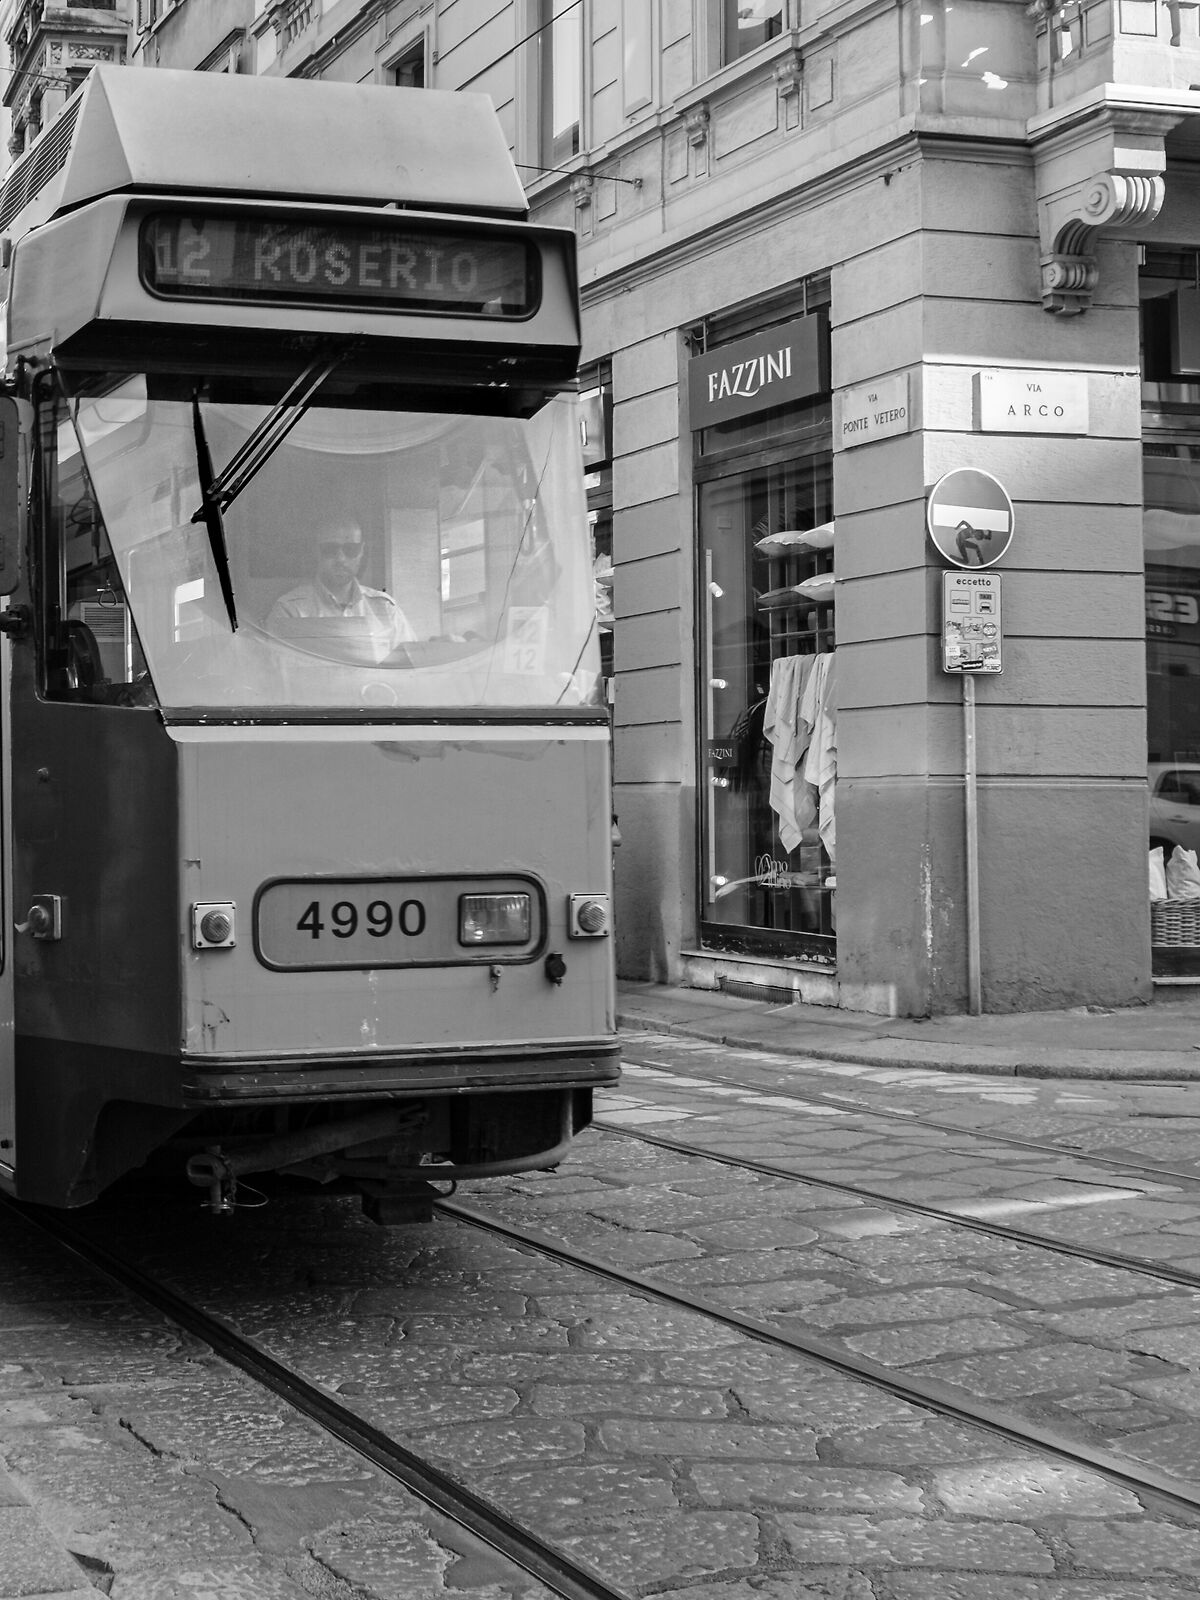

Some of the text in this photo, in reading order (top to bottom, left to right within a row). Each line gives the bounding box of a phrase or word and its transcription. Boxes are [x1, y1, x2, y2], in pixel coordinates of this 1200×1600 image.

[156, 233, 478, 292] 12 ROSERIO
[708, 346, 791, 402] FAZZINI
[1026, 384, 1042, 393] VIA
[868, 393, 878, 403] VIA
[1007, 404, 1064, 417] ARCO
[843, 407, 906, 435] PONTE VETERO
[956, 578, 992, 587] eccetto
[513, 648, 536, 670] 12
[708, 748, 733, 760] FAZZINI
[296, 899, 427, 939] 4990
